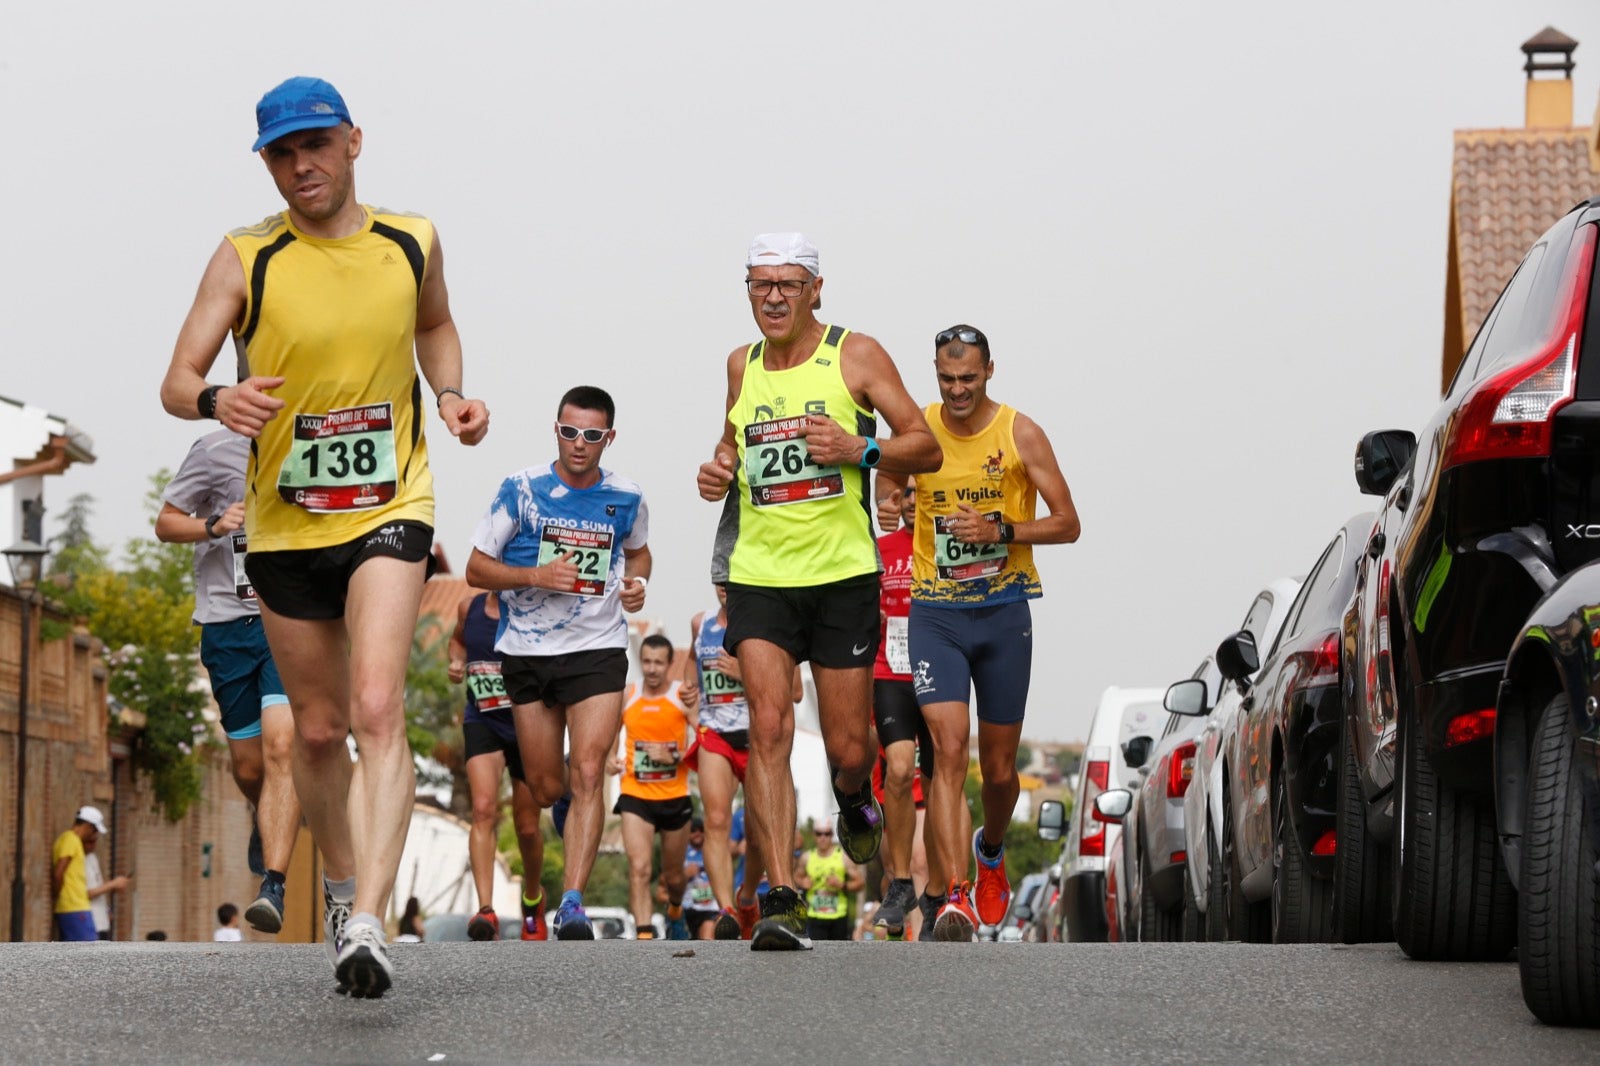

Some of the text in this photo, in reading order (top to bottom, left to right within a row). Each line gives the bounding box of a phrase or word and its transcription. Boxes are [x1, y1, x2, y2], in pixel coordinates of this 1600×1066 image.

[328, 410, 353, 426] PREMIO
[353, 409, 363, 421] DE
[364, 407, 387, 421] FONDO
[762, 421, 778, 434] GRAN
[778, 418, 799, 431] PREMIO
[799, 417, 807, 427] DE
[301, 438, 378, 478] 138
[539, 516, 615, 533] TODO SUMA
